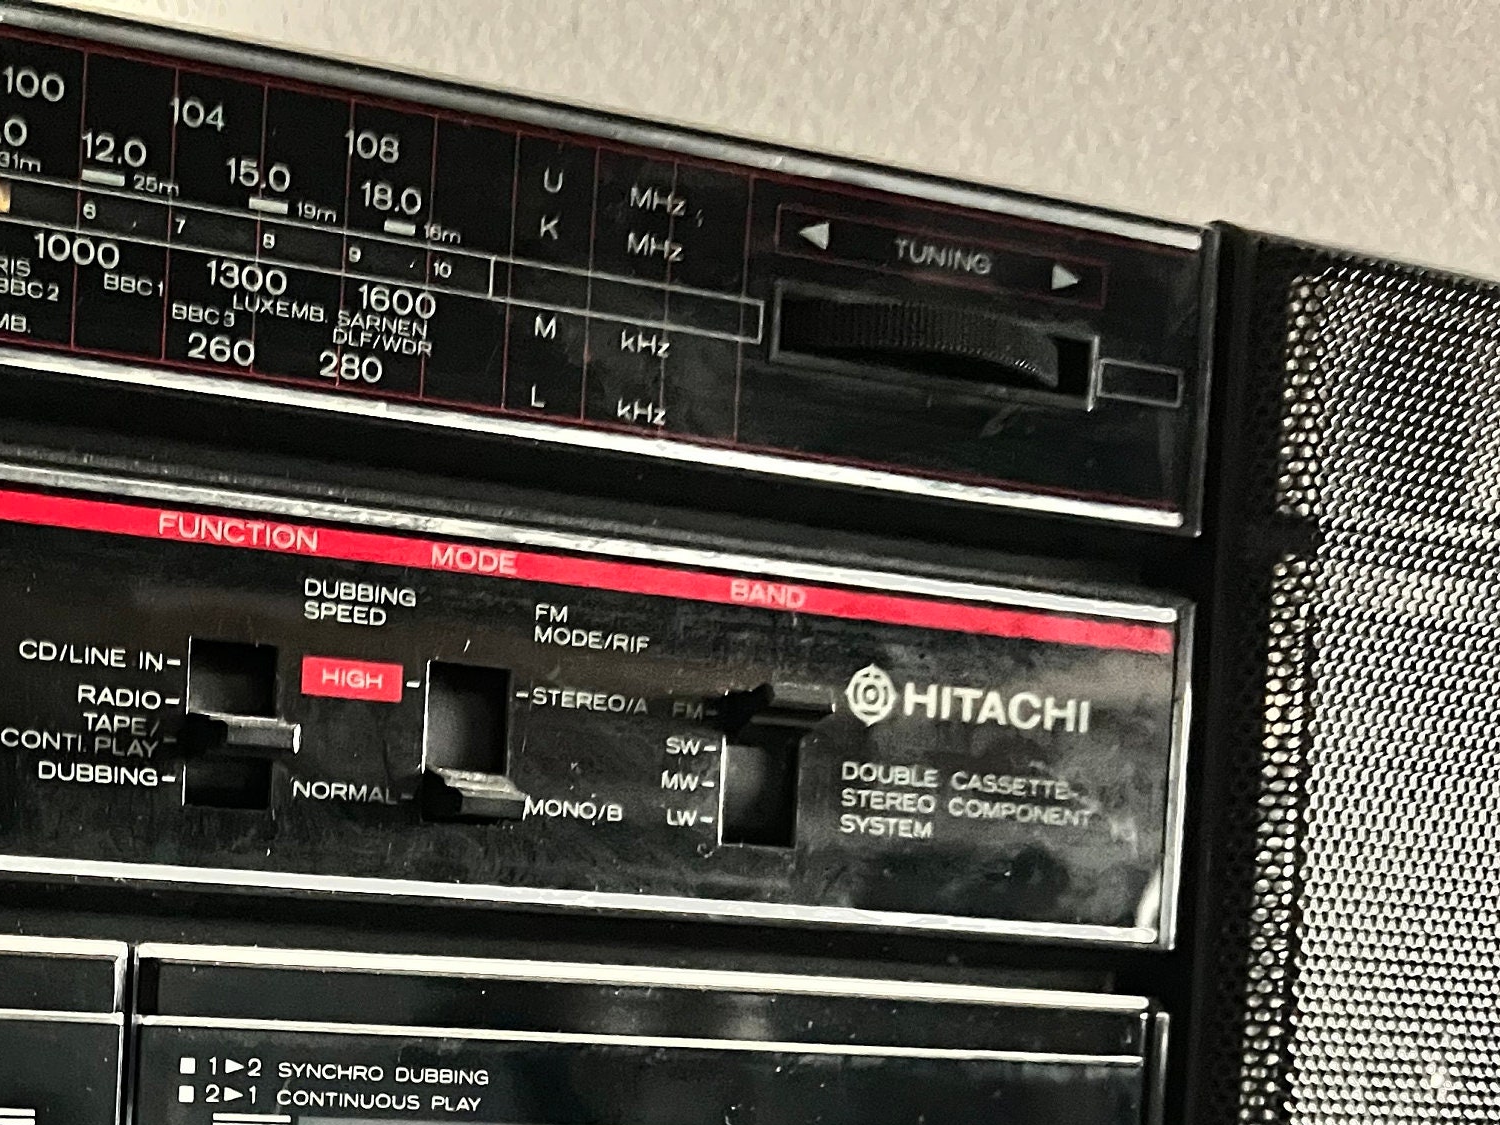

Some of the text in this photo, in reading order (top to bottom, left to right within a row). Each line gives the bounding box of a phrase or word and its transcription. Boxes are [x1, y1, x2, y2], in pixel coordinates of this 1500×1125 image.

[3, 65, 65, 102] 100
[170, 98, 225, 132] 104
[82, 131, 147, 167] 12.0
[344, 129, 400, 164] 108
[133, 174, 180, 196] 25m
[226, 157, 290, 192] 15.0
[545, 171, 563, 193] U
[361, 180, 422, 215] 18.0
[630, 187, 686, 217] MHz
[296, 201, 337, 223] 19m
[175, 218, 186, 235] 7
[541, 216, 559, 240] K
[34, 232, 120, 269] 1000
[262, 233, 276, 249] 8
[627, 233, 684, 262] MHz
[433, 260, 452, 279] 10
[894, 238, 992, 274] TUNING
[207, 259, 287, 296] 1300
[233, 293, 328, 323] LUXEMB.
[358, 284, 436, 319] 1600
[338, 310, 427, 339] SARNEN
[535, 316, 557, 339] M
[187, 331, 255, 366] 260
[333, 327, 432, 357] DLF/WDR
[621, 330, 672, 358] kHz
[319, 350, 383, 383] 280
[531, 386, 546, 407] L
[617, 398, 666, 426] kHz
[159, 511, 319, 552] FUNCTION
[431, 544, 519, 576] MODE
[304, 578, 416, 607] DUBBING
[730, 579, 806, 609] BAND
[304, 602, 386, 626] SPEED
[535, 604, 568, 625] FM
[534, 626, 650, 654] MODE/RIF
[19, 640, 127, 669] CD/LINE
[320, 667, 383, 691] HIGH
[78, 683, 161, 710] RADIO
[904, 682, 1090, 734] HITACHI
[83, 712, 161, 737] TAPE/
[95, 735, 159, 758] PLAY
[666, 736, 701, 756] SW
[38, 760, 158, 787] DUBBING
[661, 770, 699, 792] MW
[842, 761, 1071, 801] DOUBLE CASSETTE
[292, 778, 396, 804] NORMAL
[526, 798, 623, 823] MONO/B
[667, 809, 697, 827] LW
[841, 789, 1096, 828] STEREO COMPONENT
[840, 816, 933, 839] SYSTEM
[278, 1062, 490, 1086] SYNCHRO DUBBING
[276, 1089, 481, 1112] CONTINUOUS PLAY
